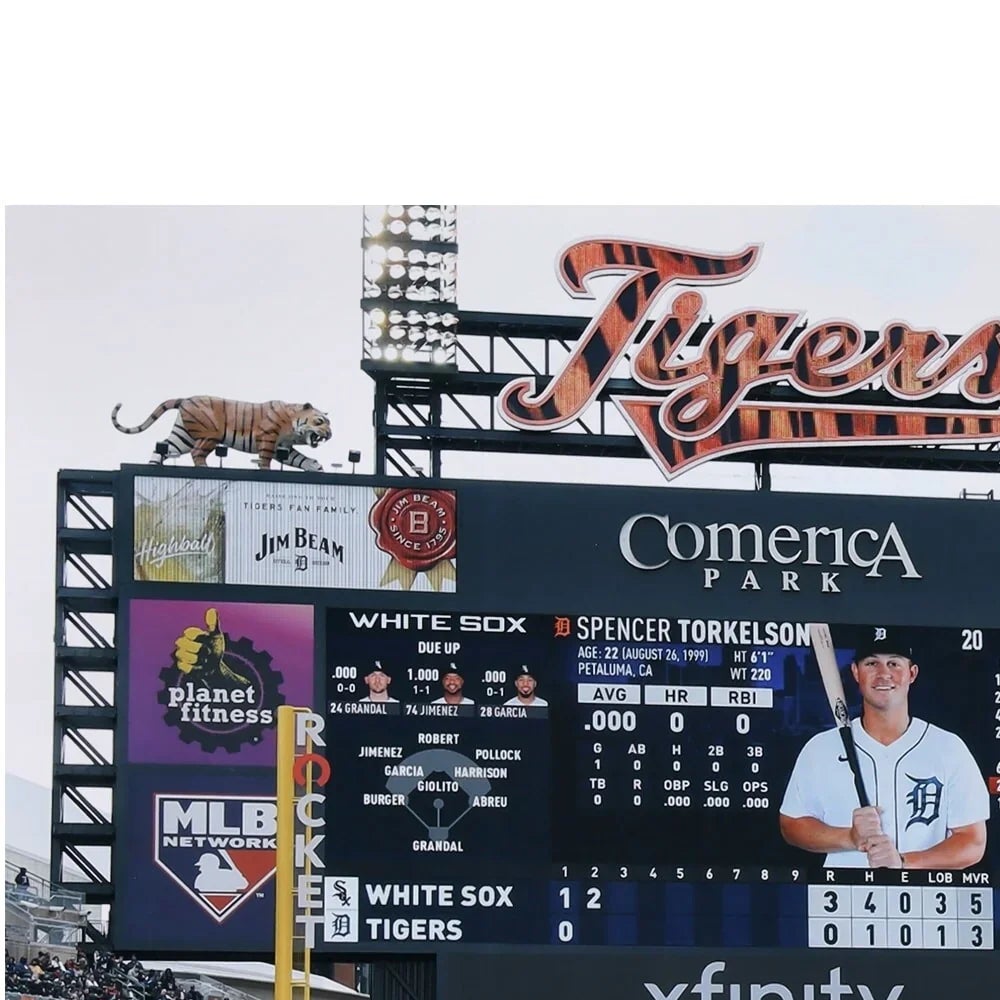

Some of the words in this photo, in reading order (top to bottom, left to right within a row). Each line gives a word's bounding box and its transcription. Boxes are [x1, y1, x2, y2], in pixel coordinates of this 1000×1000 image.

[289, 504, 310, 512] FAN
[392, 497, 408, 515] JIM
[413, 494, 446, 517] BEAM
[255, 533, 289, 561] JIM
[295, 527, 344, 563] BEAM
[390, 525, 420, 550] SINCE
[426, 527, 446, 548] 1795
[135, 532, 215, 568] Highball
[704, 568, 840, 593] PARK
[349, 612, 452, 630] WHITE
[460, 616, 527, 633] SOX
[577, 616, 671, 643] SPENCER
[678, 619, 811, 647] TORKELSON
[962, 629, 983, 650] 20
[418, 641, 442, 654] DUE
[445, 642, 461, 655] UP
[578, 647, 602, 660] AGE:
[605, 647, 619, 660] 22
[622, 647, 664, 661] (AUGUST
[665, 649, 680, 662] 26,
[682, 649, 709, 663] 1999)
[407, 668, 439, 682] 1.000
[578, 663, 636, 678] PETALUMA,
[639, 665, 653, 677] CA
[730, 667, 747, 680] WT
[751, 668, 771, 681] 220
[168, 682, 256, 708] planet
[593, 688, 627, 701] AVG
[665, 689, 689, 703] HR
[729, 691, 757, 705] RBI
[180, 702, 273, 724] fitness
[344, 704, 387, 715] GRANDAL
[420, 705, 459, 716] JIMENEZ
[494, 707, 527, 718] GARCIA
[584, 710, 637, 732] .000
[418, 733, 460, 744] ROBERT
[358, 747, 403, 758] JIMENEZ
[475, 749, 521, 761] POLLOCK
[454, 767, 508, 778] HARRISON
[417, 781, 459, 792] GIOLITO
[664, 779, 690, 791] OBP
[704, 781, 728, 792] SLG
[743, 781, 768, 793] OPS
[363, 794, 405, 806] BURGER
[472, 796, 508, 807] ABREU
[163, 800, 277, 836] MLB
[163, 836, 277, 849] NETWORK
[365, 884, 453, 907] WHITE
[460, 885, 513, 908] SOX
[366, 918, 463, 941] TIGERS
